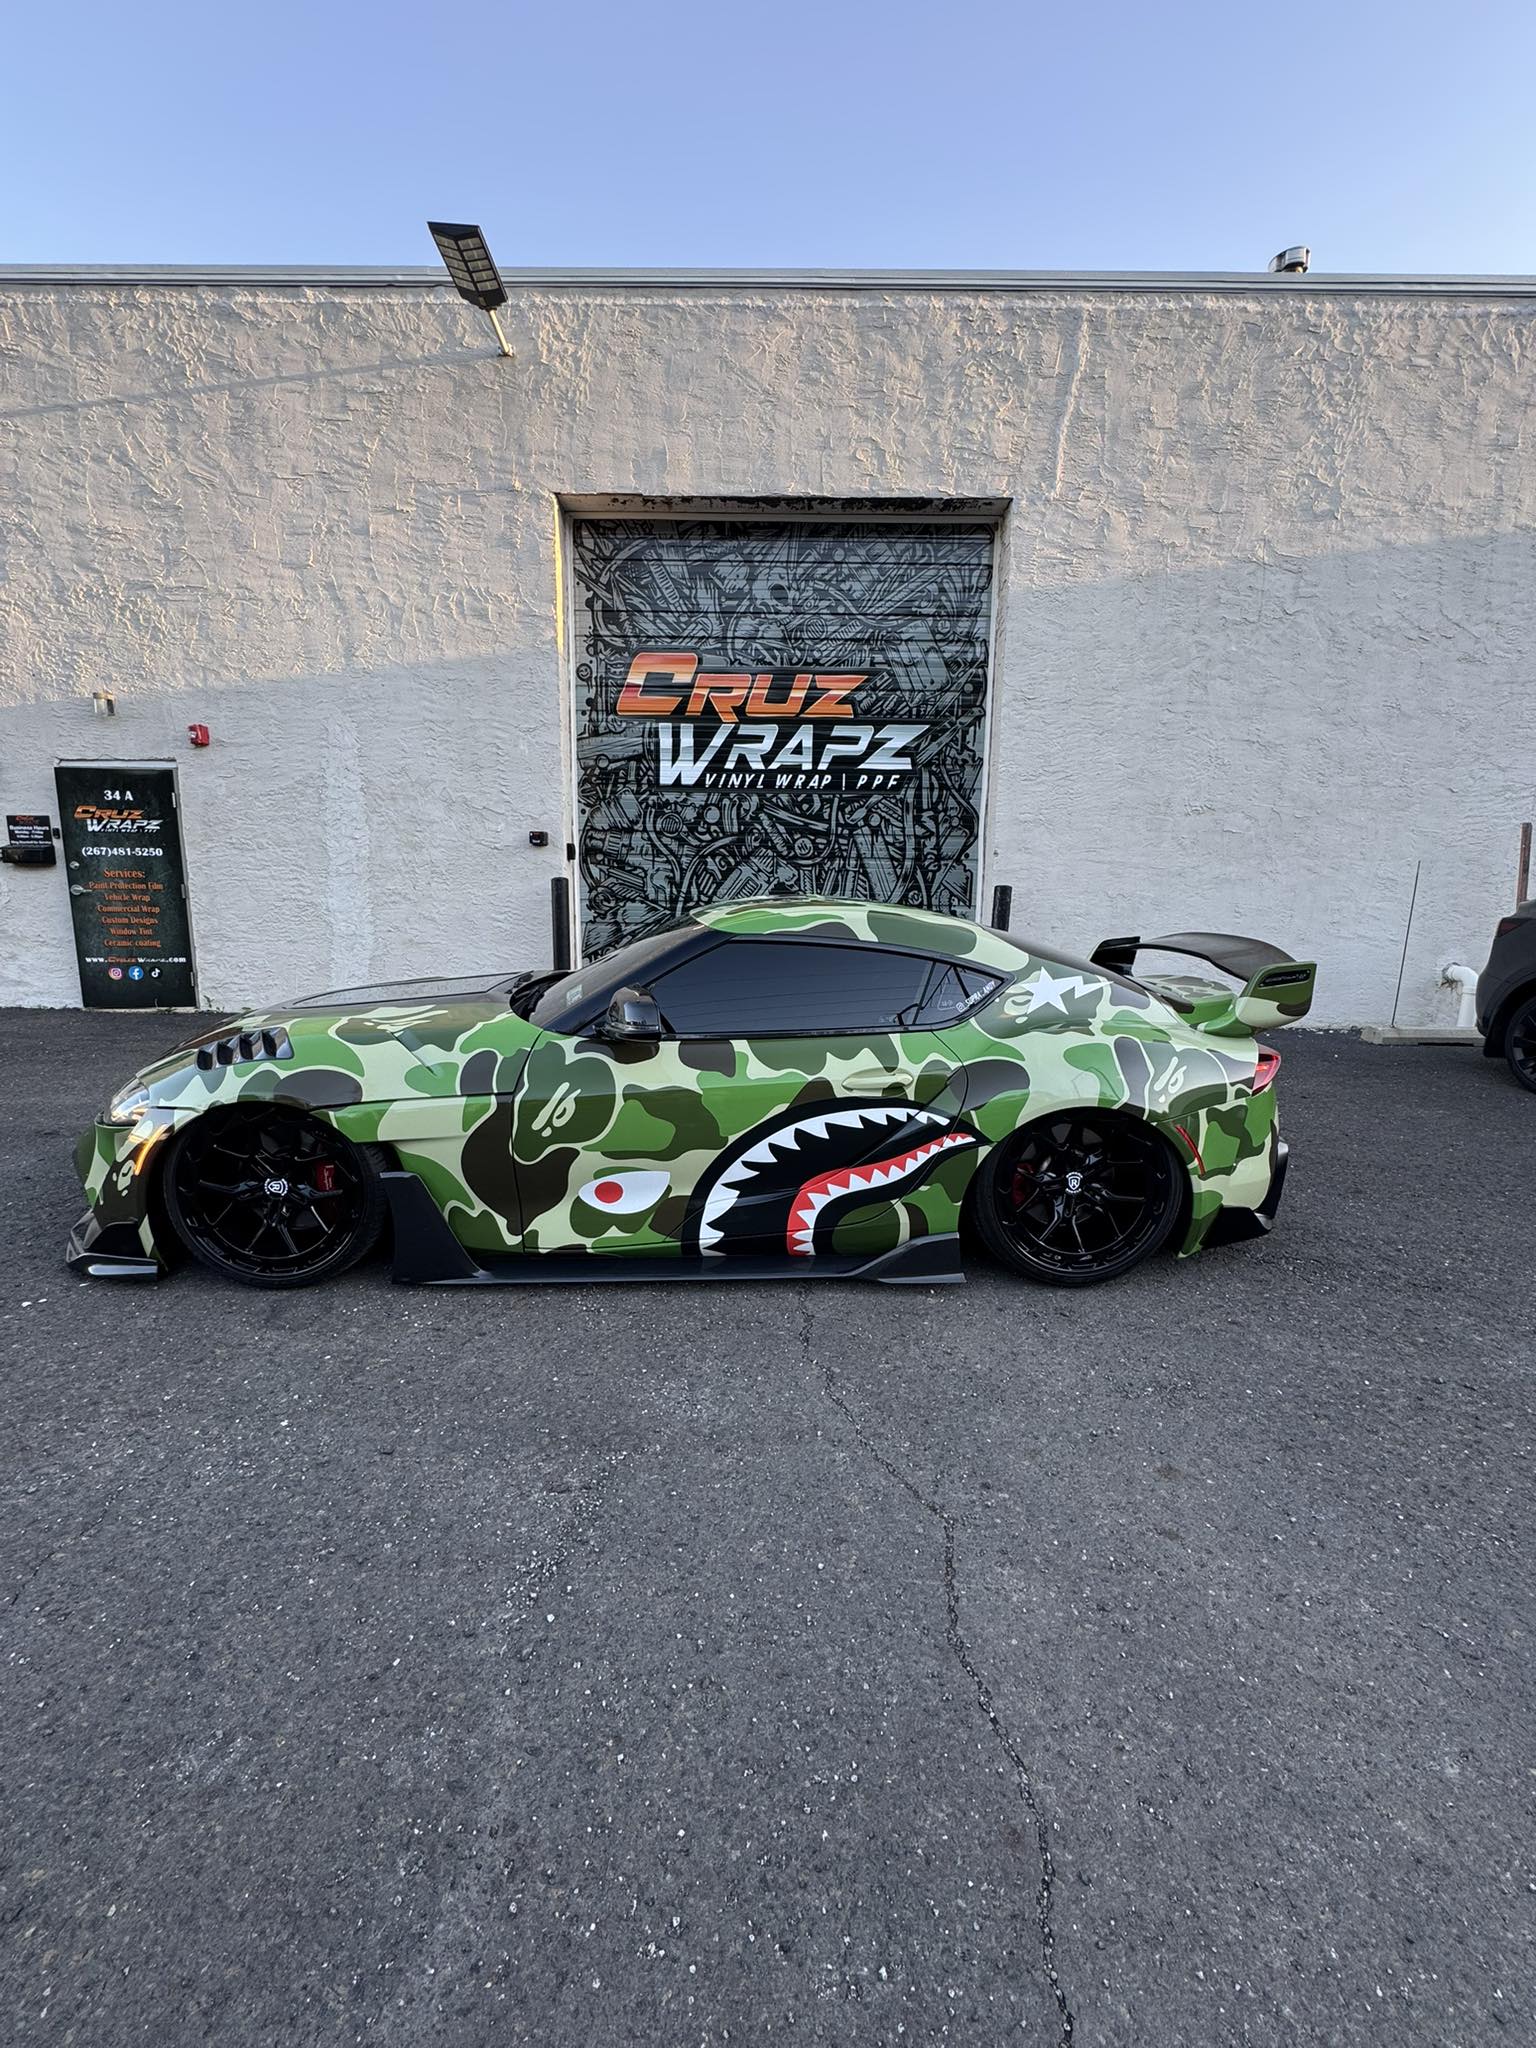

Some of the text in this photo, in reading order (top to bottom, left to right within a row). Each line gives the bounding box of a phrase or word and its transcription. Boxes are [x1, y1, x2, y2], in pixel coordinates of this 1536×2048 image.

[616, 651, 869, 723] CRUZ
[658, 722, 931, 787] WRAPZ
[704, 773, 765, 789] VINYL
[774, 774, 832, 790] WRAP
[855, 774, 900, 790] PPF
[103, 789, 134, 801] 34 A
[74, 805, 145, 819] CRUZ
[86, 818, 163, 832] WRAPZ
[81, 846, 164, 857] (267)481-5250
[103, 868, 146, 878] Services:
[109, 881, 147, 890] Protection
[104, 893, 151, 903] Vehicle Wrap
[97, 904, 160, 914] Commercial Wrap
[101, 916, 159, 925] Custom Designs
[103, 939, 133, 947] Ceramic
